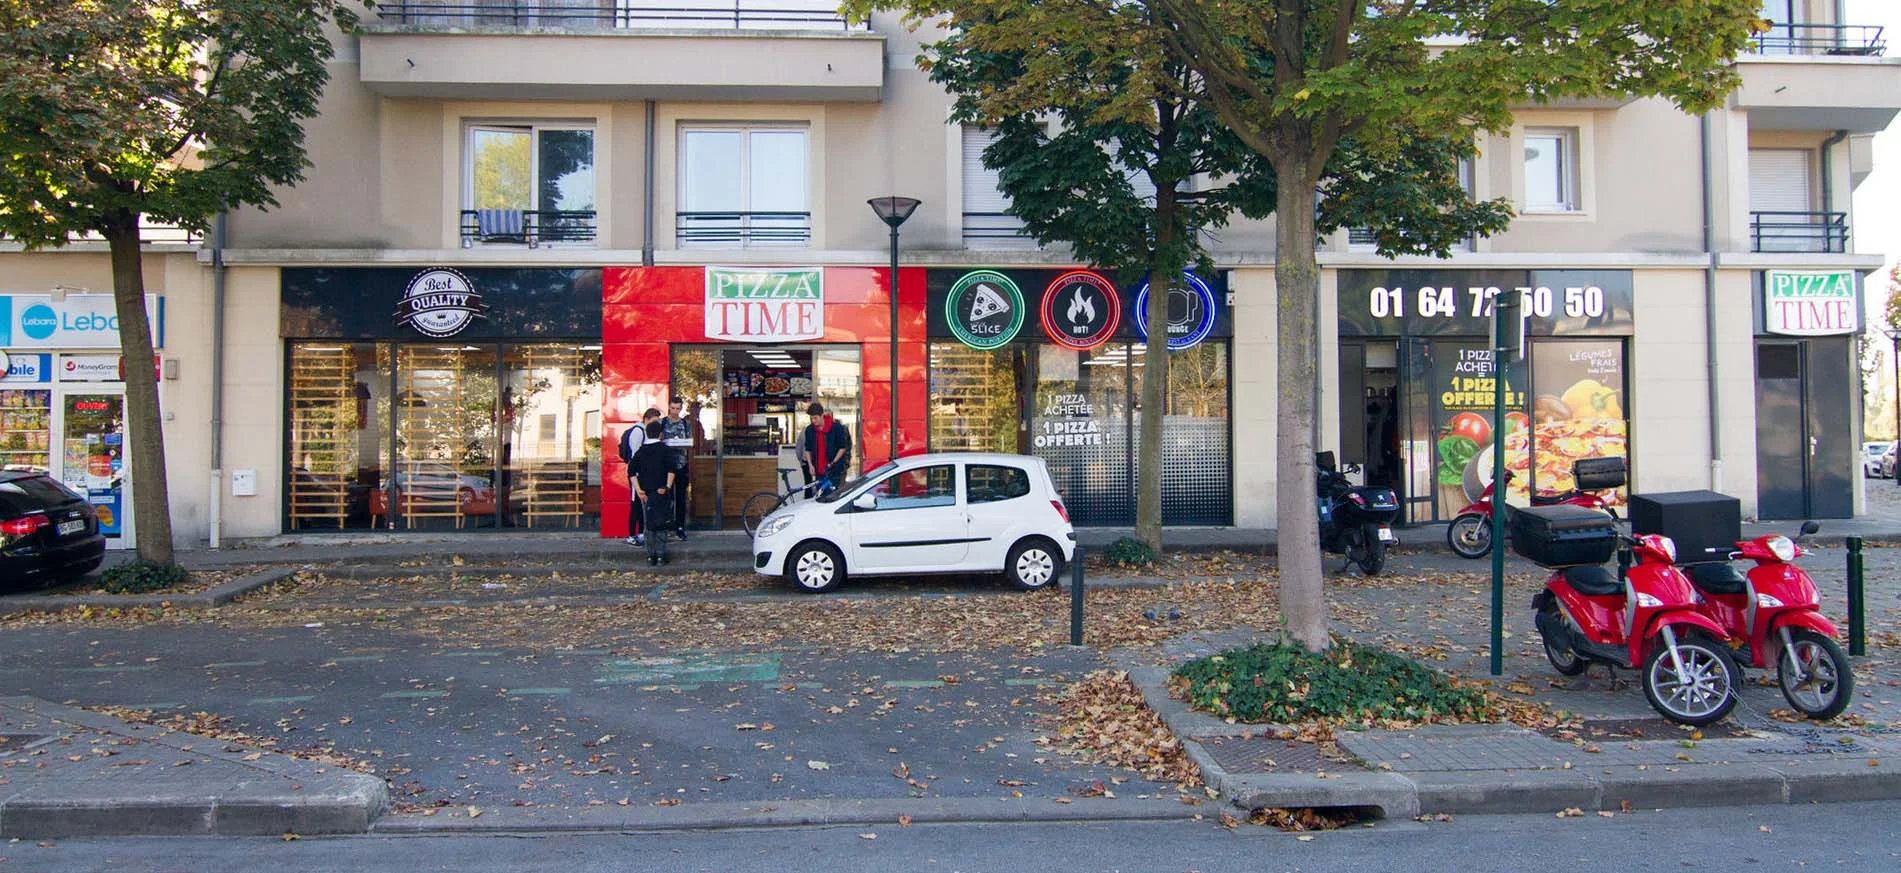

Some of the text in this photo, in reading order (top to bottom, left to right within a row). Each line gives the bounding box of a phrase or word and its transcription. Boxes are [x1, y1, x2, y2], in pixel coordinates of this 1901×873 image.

[424, 277, 452, 291] Best
[411, 294, 469, 312] QUALITY
[1370, 287, 1404, 317] 01
[1418, 287, 1456, 317] 64
[1564, 287, 1604, 317] 50
[712, 302, 818, 336] TIME
[1775, 300, 1852, 330] TIME
[971, 324, 1001, 334] SLICE
[1168, 325, 1190, 333] OUNGE
[1459, 349, 1490, 360] 1 PIZZ
[9, 364, 35, 375] bile
[1451, 376, 1460, 391] 1
[1048, 394, 1086, 404] 1 PIZZA
[1441, 391, 1524, 405] OFFERE !
[1044, 402, 1094, 415] ACHETÉE
[1043, 421, 1098, 434] 1 PIZZA
[1034, 433, 1110, 447] OFFERTE !
